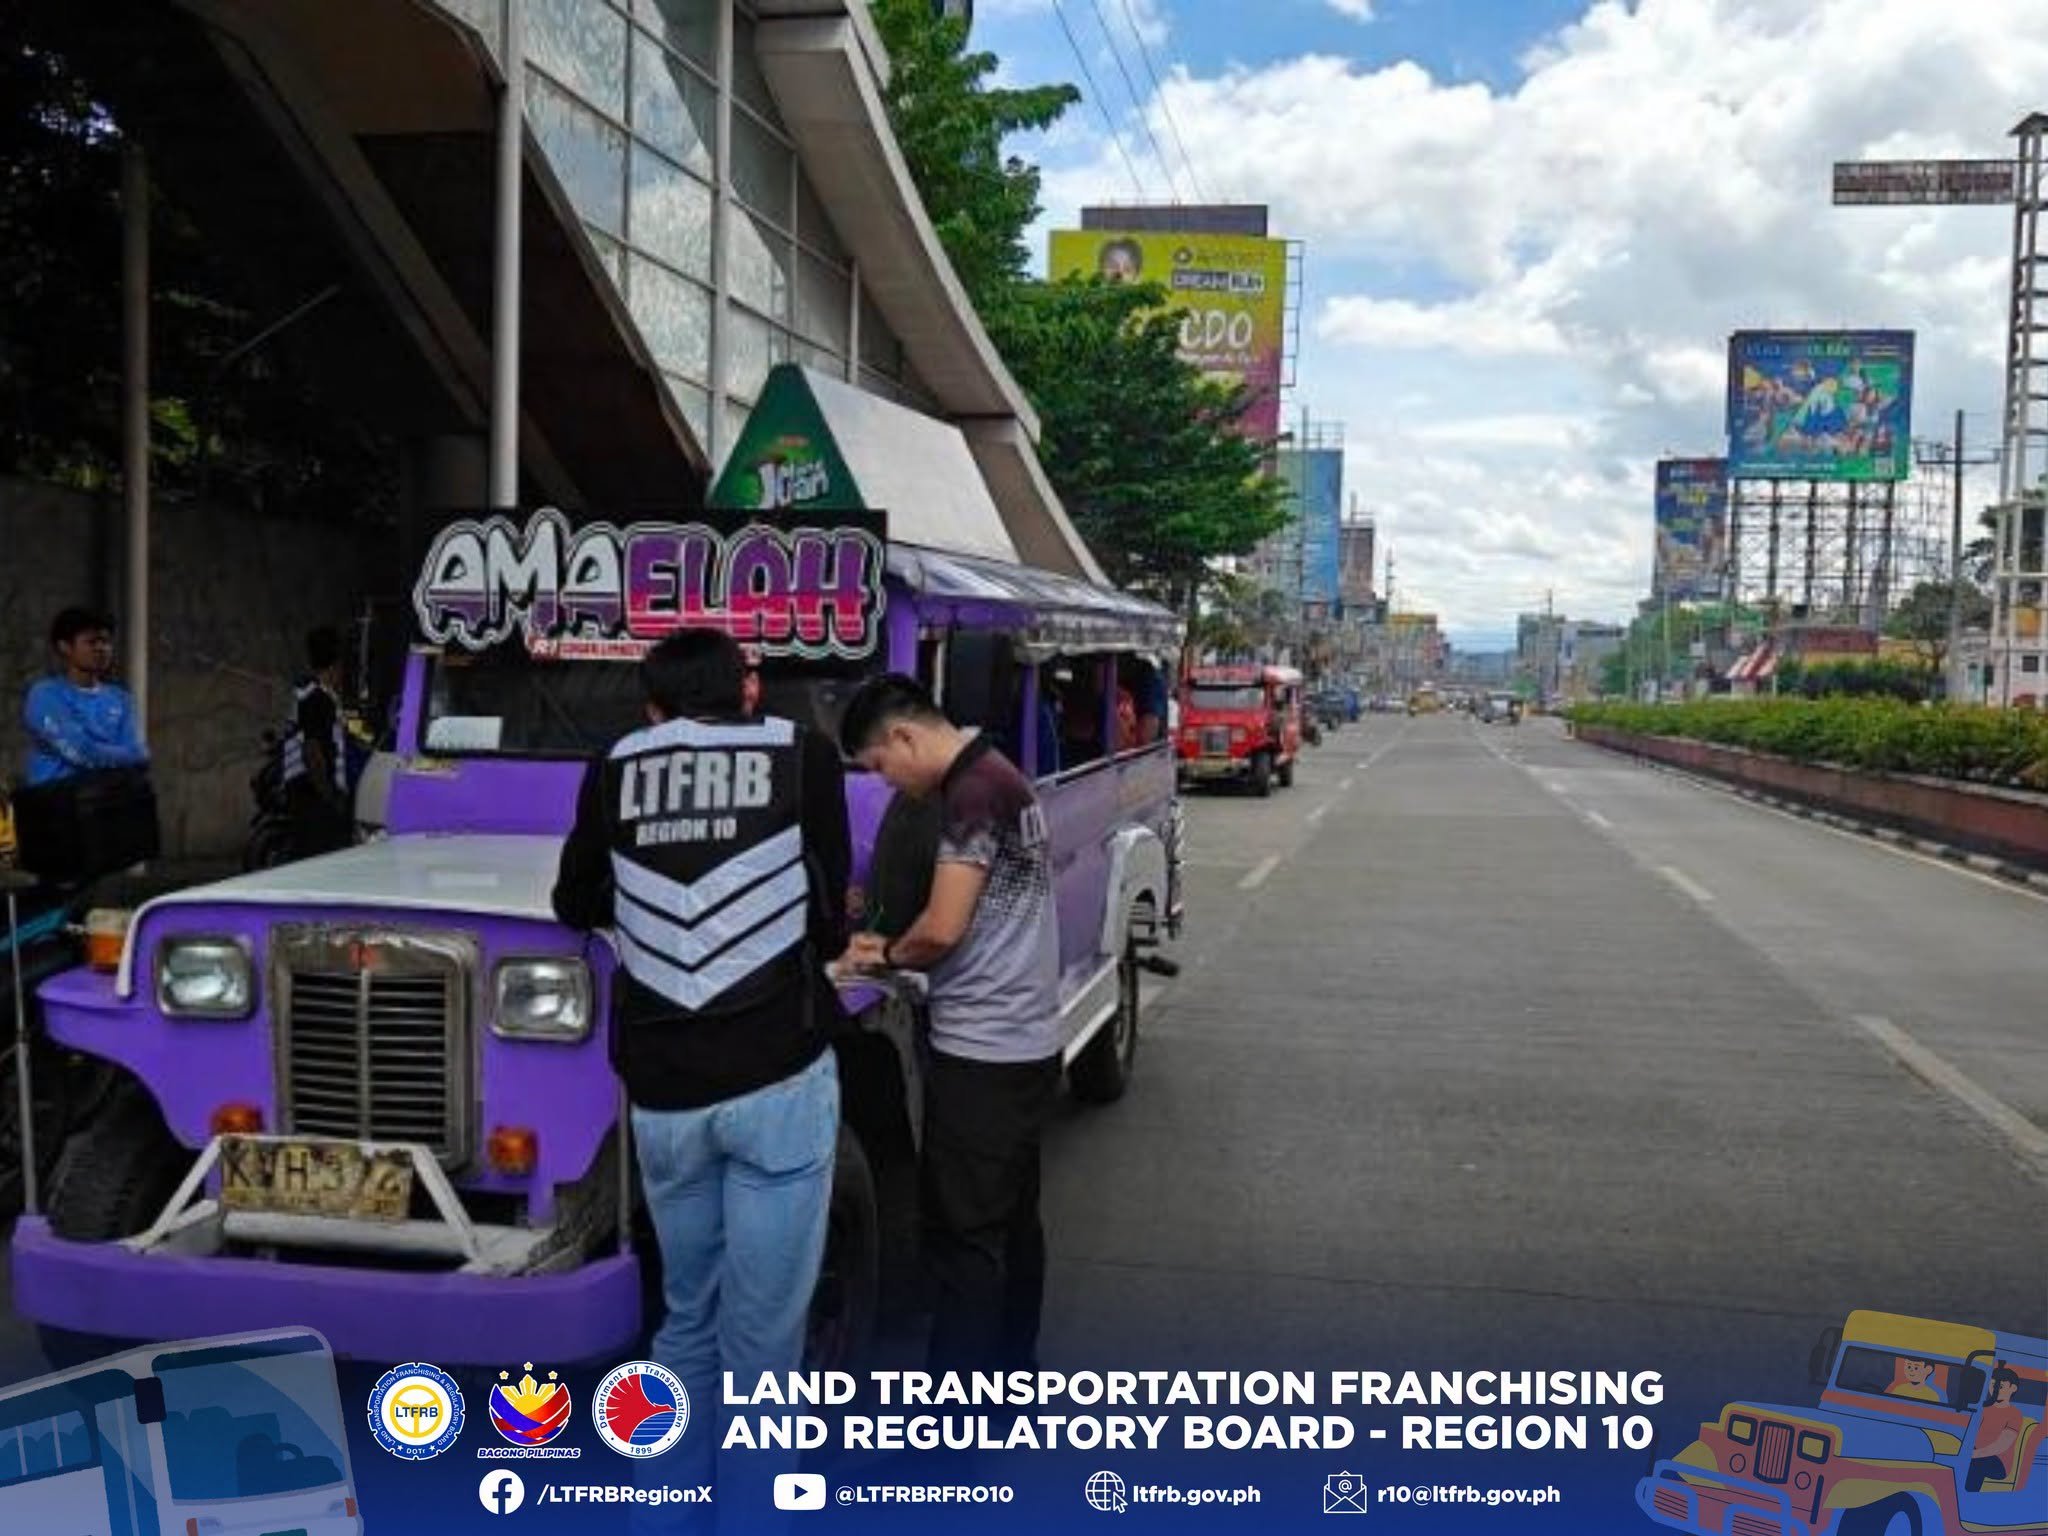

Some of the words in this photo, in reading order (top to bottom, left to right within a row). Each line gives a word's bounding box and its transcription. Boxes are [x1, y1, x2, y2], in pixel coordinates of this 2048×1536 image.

[1178, 309, 1253, 349] CDO
[620, 751, 772, 820] LTFRB
[636, 818, 708, 846] REGION
[713, 816, 738, 840] 10
